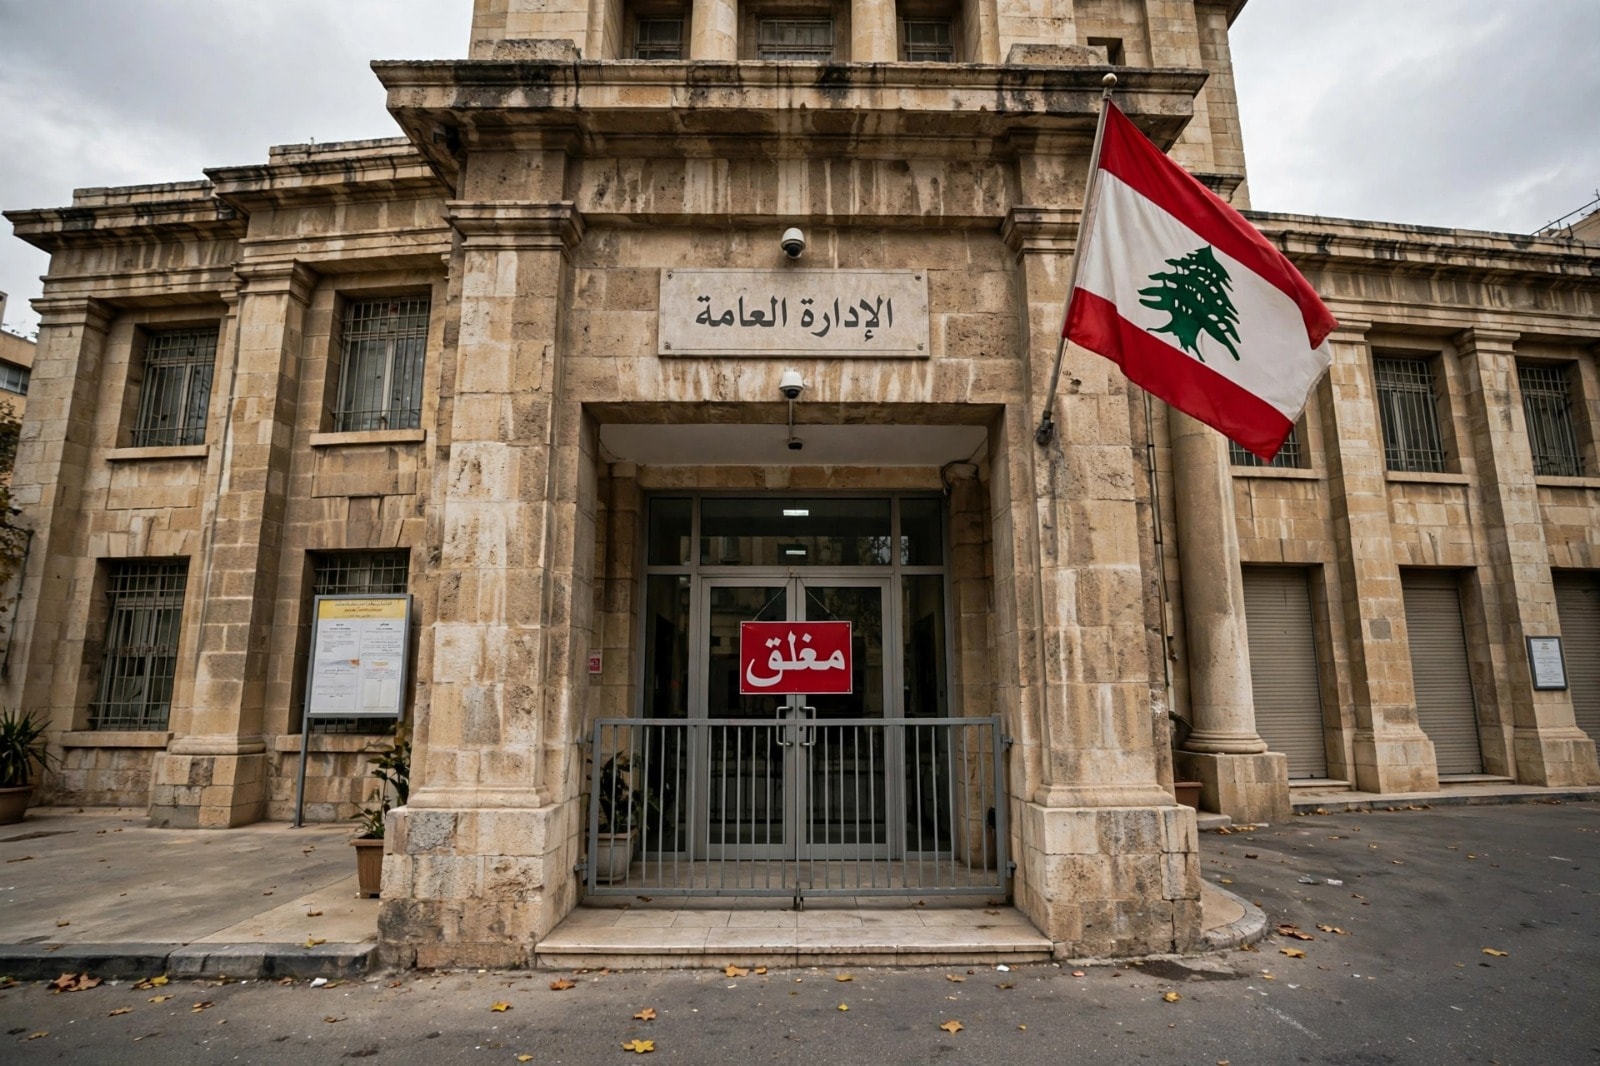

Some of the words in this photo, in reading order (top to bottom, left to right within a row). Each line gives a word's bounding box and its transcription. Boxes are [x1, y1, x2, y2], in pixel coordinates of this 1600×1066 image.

[695, 295, 788, 328] العامة
[800, 296, 894, 342] الإدارة
[746, 630, 846, 687] مغلق
